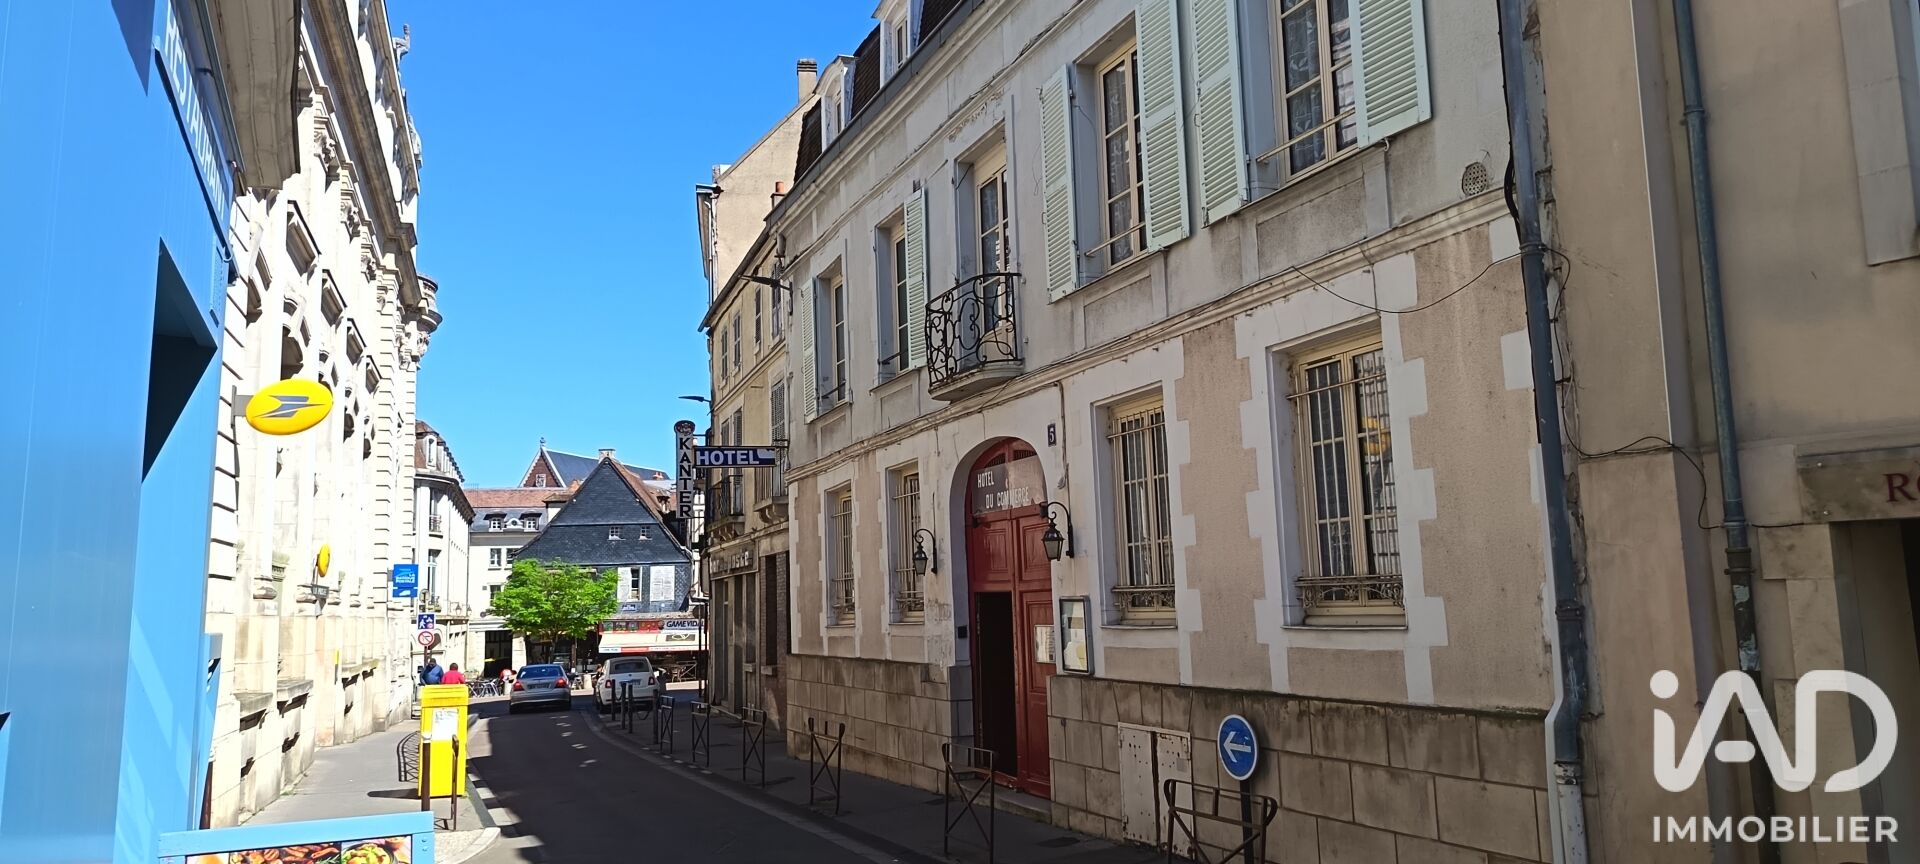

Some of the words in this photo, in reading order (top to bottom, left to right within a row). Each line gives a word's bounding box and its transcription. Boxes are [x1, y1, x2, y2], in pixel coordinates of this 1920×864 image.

[164, 0, 225, 220] RESTAURANT
[1049, 427, 1055, 443] 5
[695, 450, 760, 465] HOTEL
[679, 437, 692, 517] KANTER
[977, 471, 995, 488] HOTEL
[986, 493, 994, 509] DU
[997, 487, 1029, 507] COMMERCE
